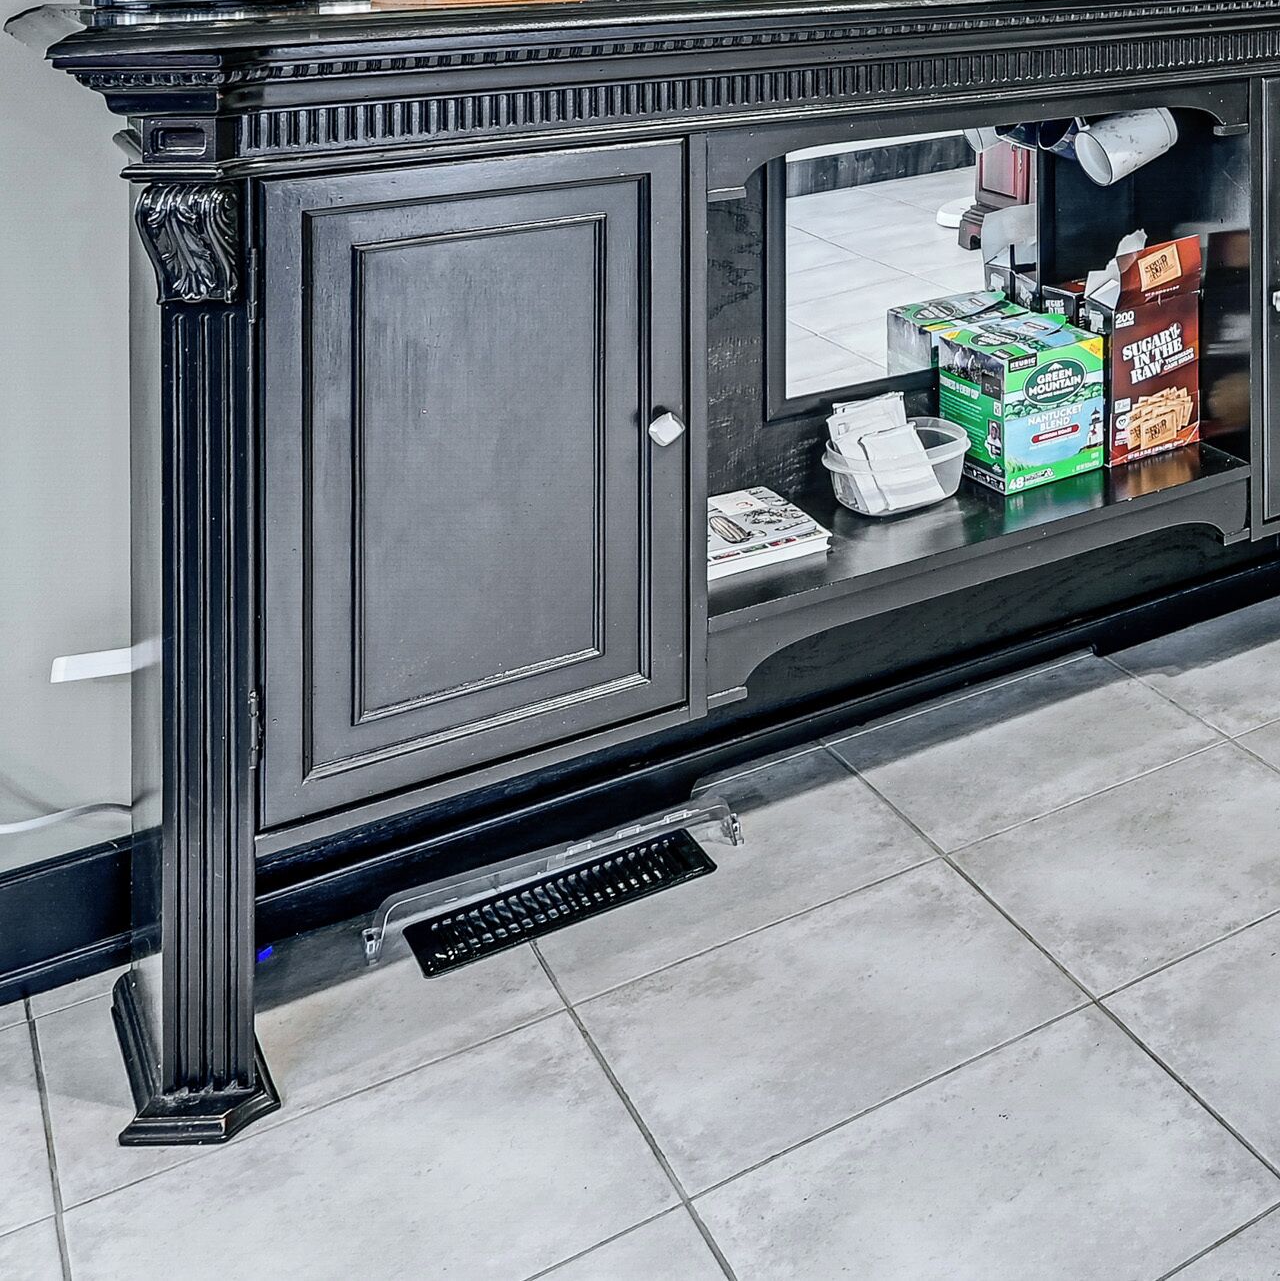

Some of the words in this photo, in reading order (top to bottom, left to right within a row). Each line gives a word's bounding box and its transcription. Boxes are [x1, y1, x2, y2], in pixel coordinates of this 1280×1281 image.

[1115, 310, 1135, 324] 200
[1122, 328, 1173, 361] SUGAR
[1133, 351, 1151, 369] IN
[1152, 337, 1183, 361] THE
[1010, 357, 1036, 369] KEURIG
[1130, 360, 1165, 384] RAW
[1028, 375, 1082, 397] MOUNTAIN
[1036, 368, 1073, 385] GREEN
[1028, 404, 1083, 426] NANTUCKET
[1040, 417, 1071, 432] BLEND
[1008, 476, 1025, 491] 48
